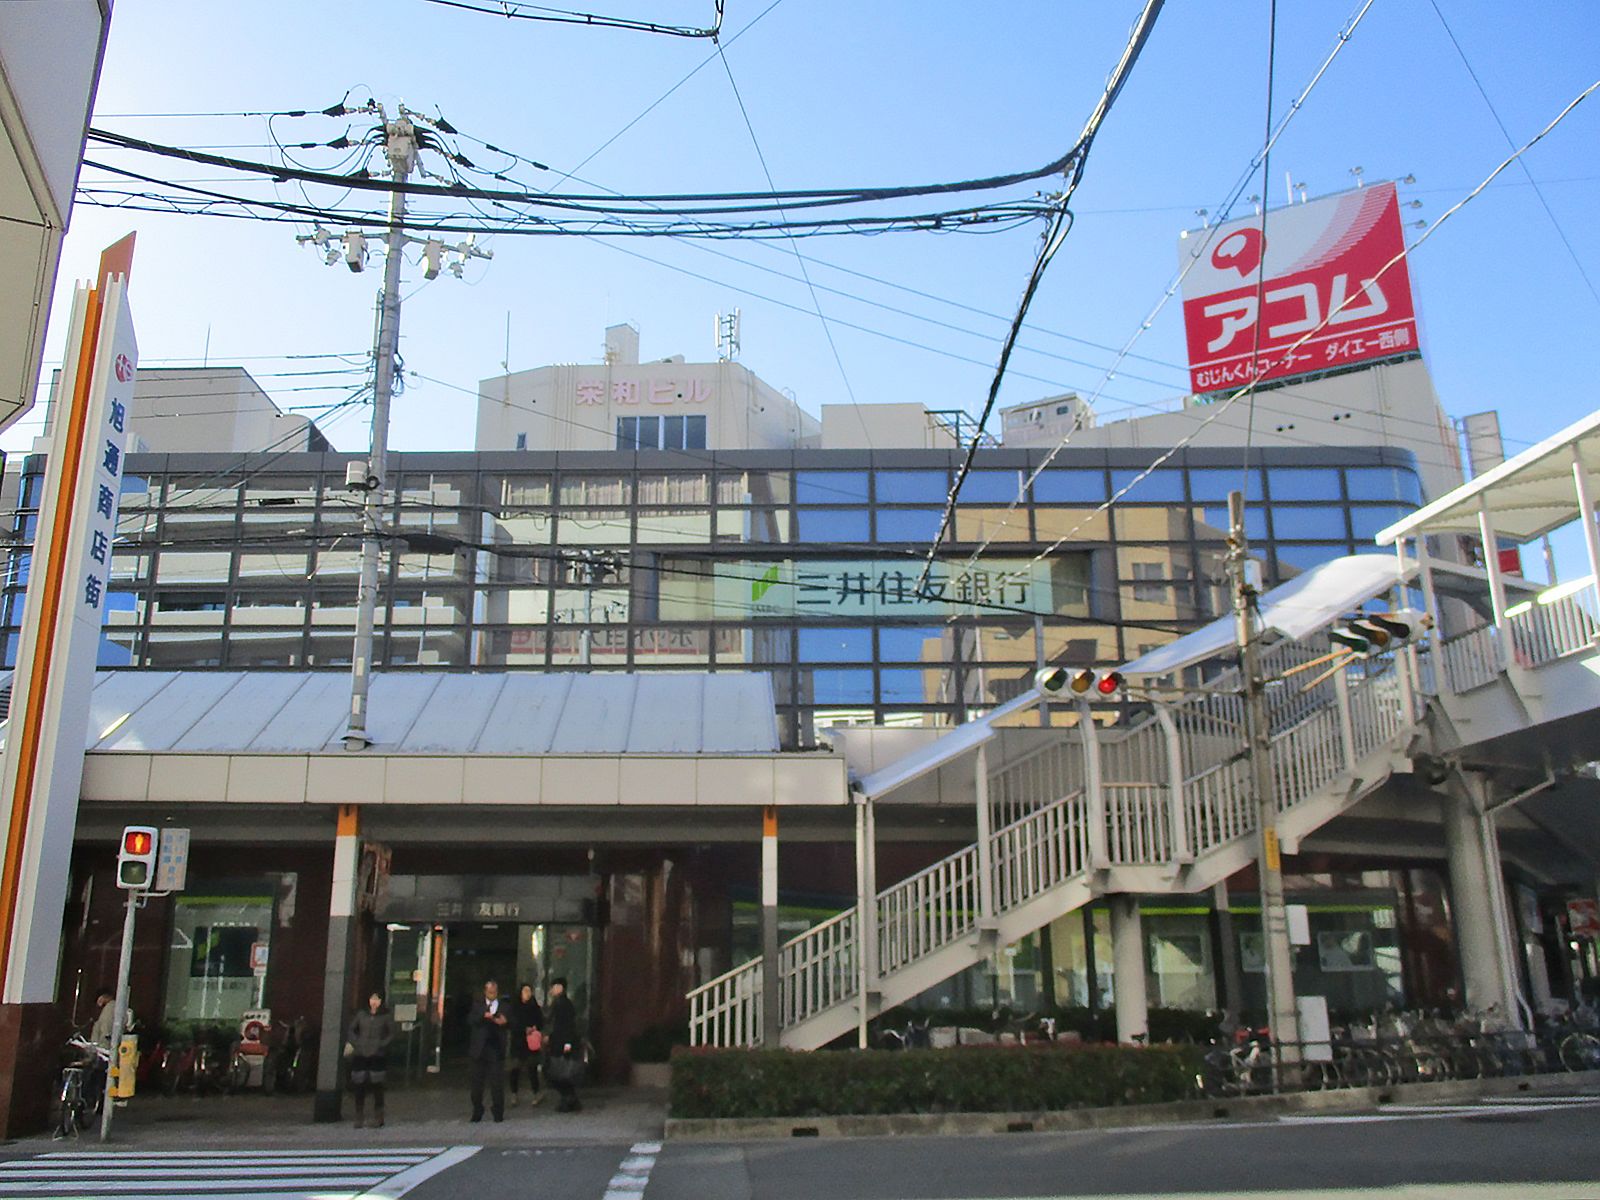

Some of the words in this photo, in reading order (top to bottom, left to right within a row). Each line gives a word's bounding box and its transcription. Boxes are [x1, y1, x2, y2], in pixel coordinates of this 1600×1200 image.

[1204, 272, 1389, 353] アコム
[576, 376, 711, 405] 栄和ビル
[85, 397, 126, 609] 旭通商店街
[797, 570, 1031, 606] 三井住友銀行
